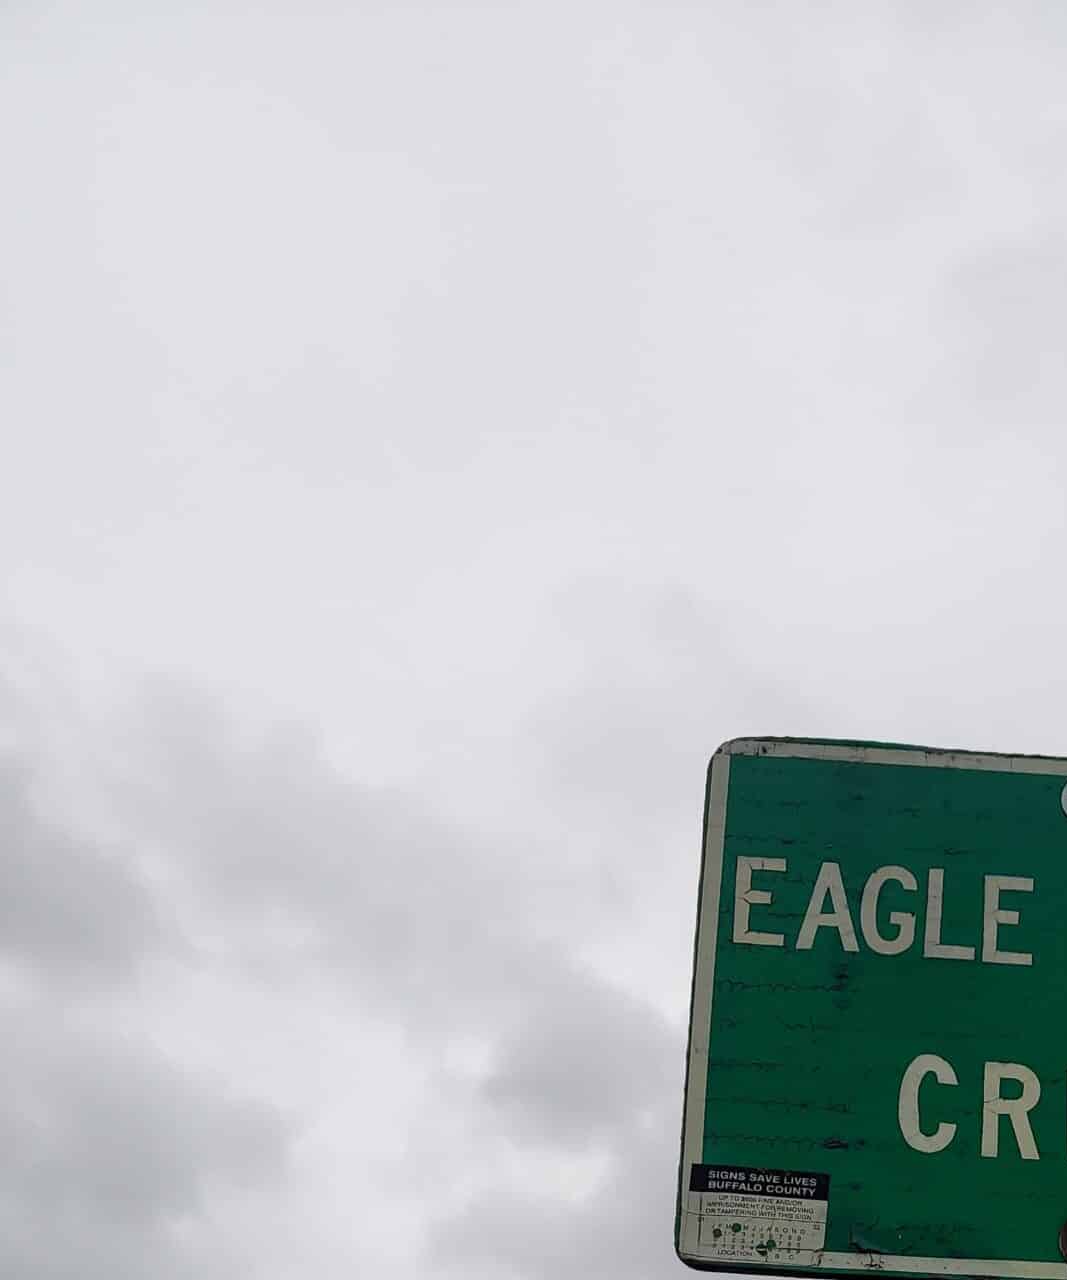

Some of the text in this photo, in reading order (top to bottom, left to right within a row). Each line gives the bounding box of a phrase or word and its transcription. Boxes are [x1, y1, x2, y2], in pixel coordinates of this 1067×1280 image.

[732, 856, 1034, 965] EAGLE
[708, 1170, 817, 1187] SIGNS SAVE LIVES
[708, 1180, 816, 1197] BUFFALO COUNTY
